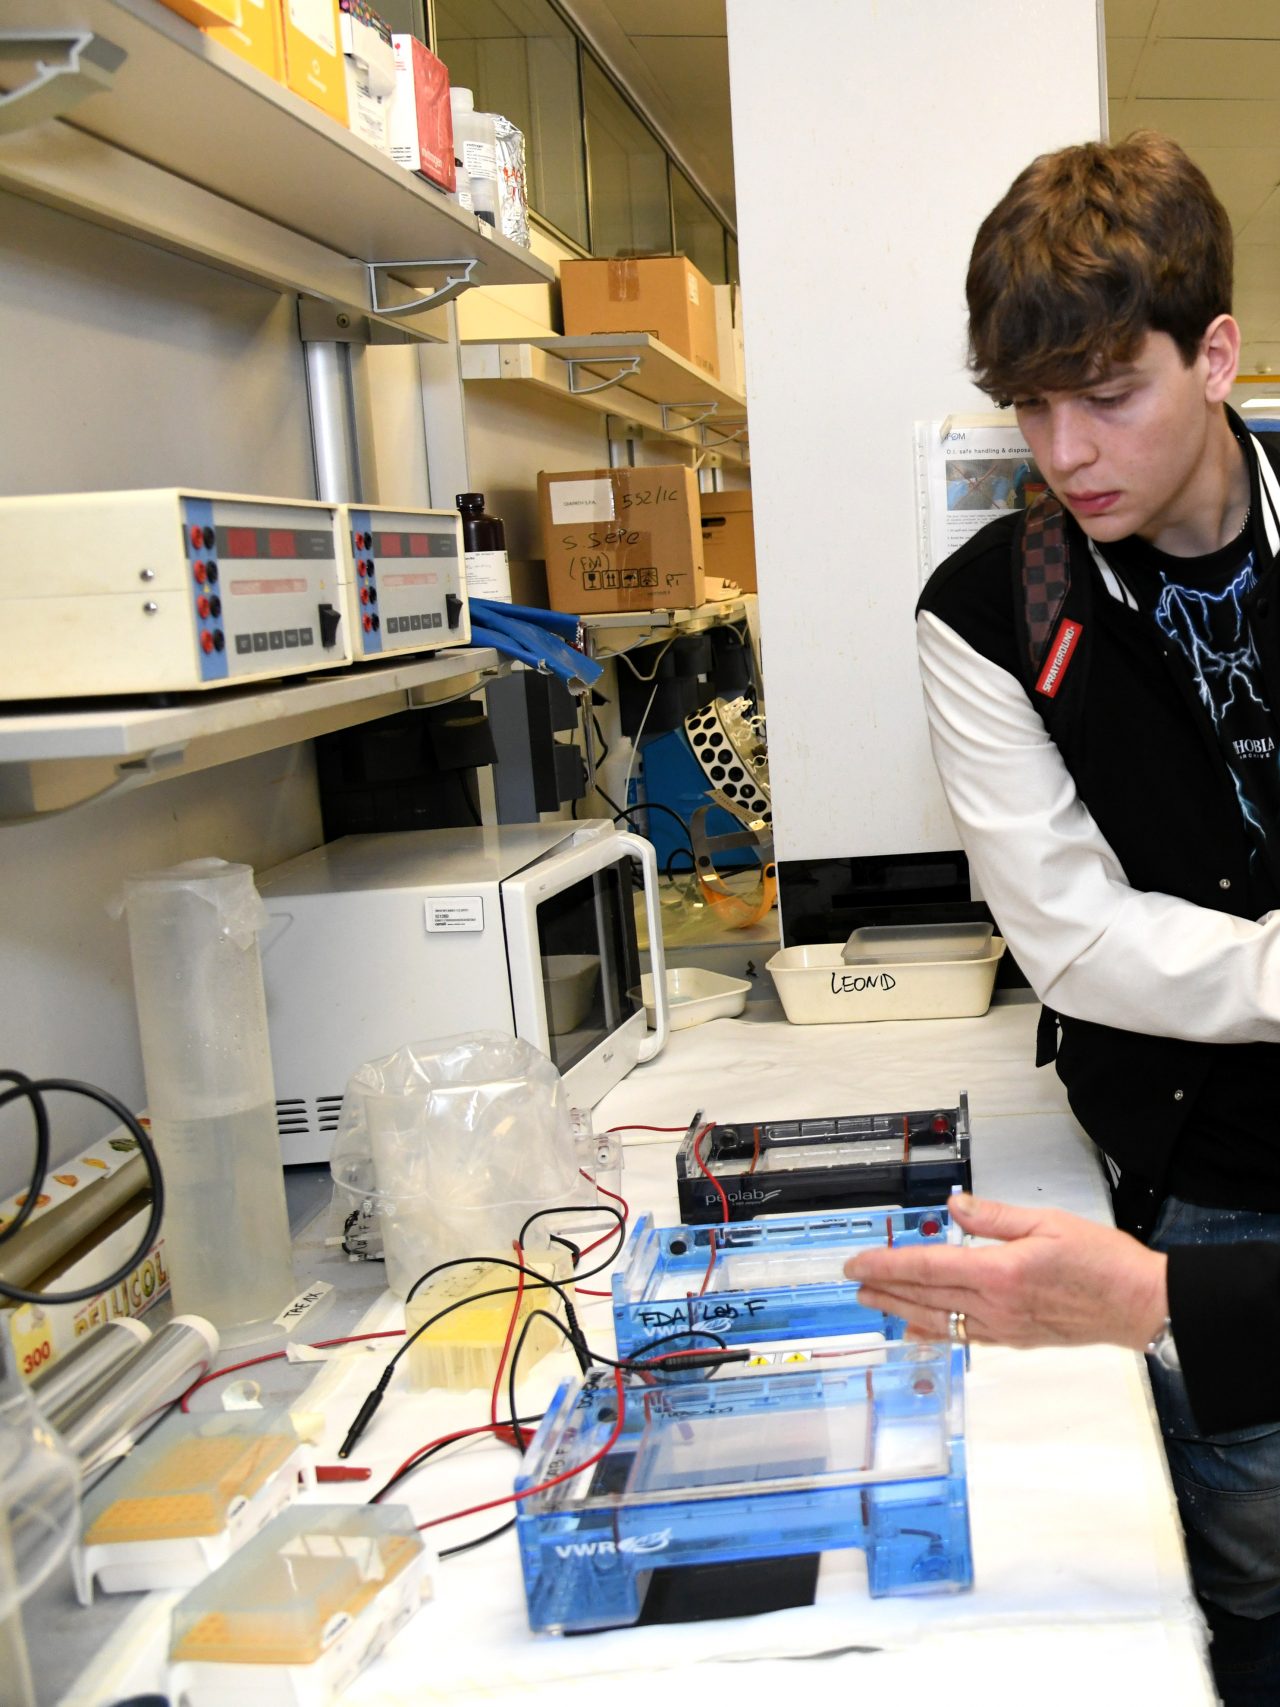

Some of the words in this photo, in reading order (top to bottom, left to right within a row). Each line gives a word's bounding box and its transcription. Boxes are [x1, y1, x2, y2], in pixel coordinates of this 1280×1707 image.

[1232, 736, 1275, 755] HOBIA
[831, 972, 896, 994] LEONID
[639, 1307, 687, 1327] FDA
[23, 1341, 51, 1375] 300
[555, 1541, 619, 1558] VWR
